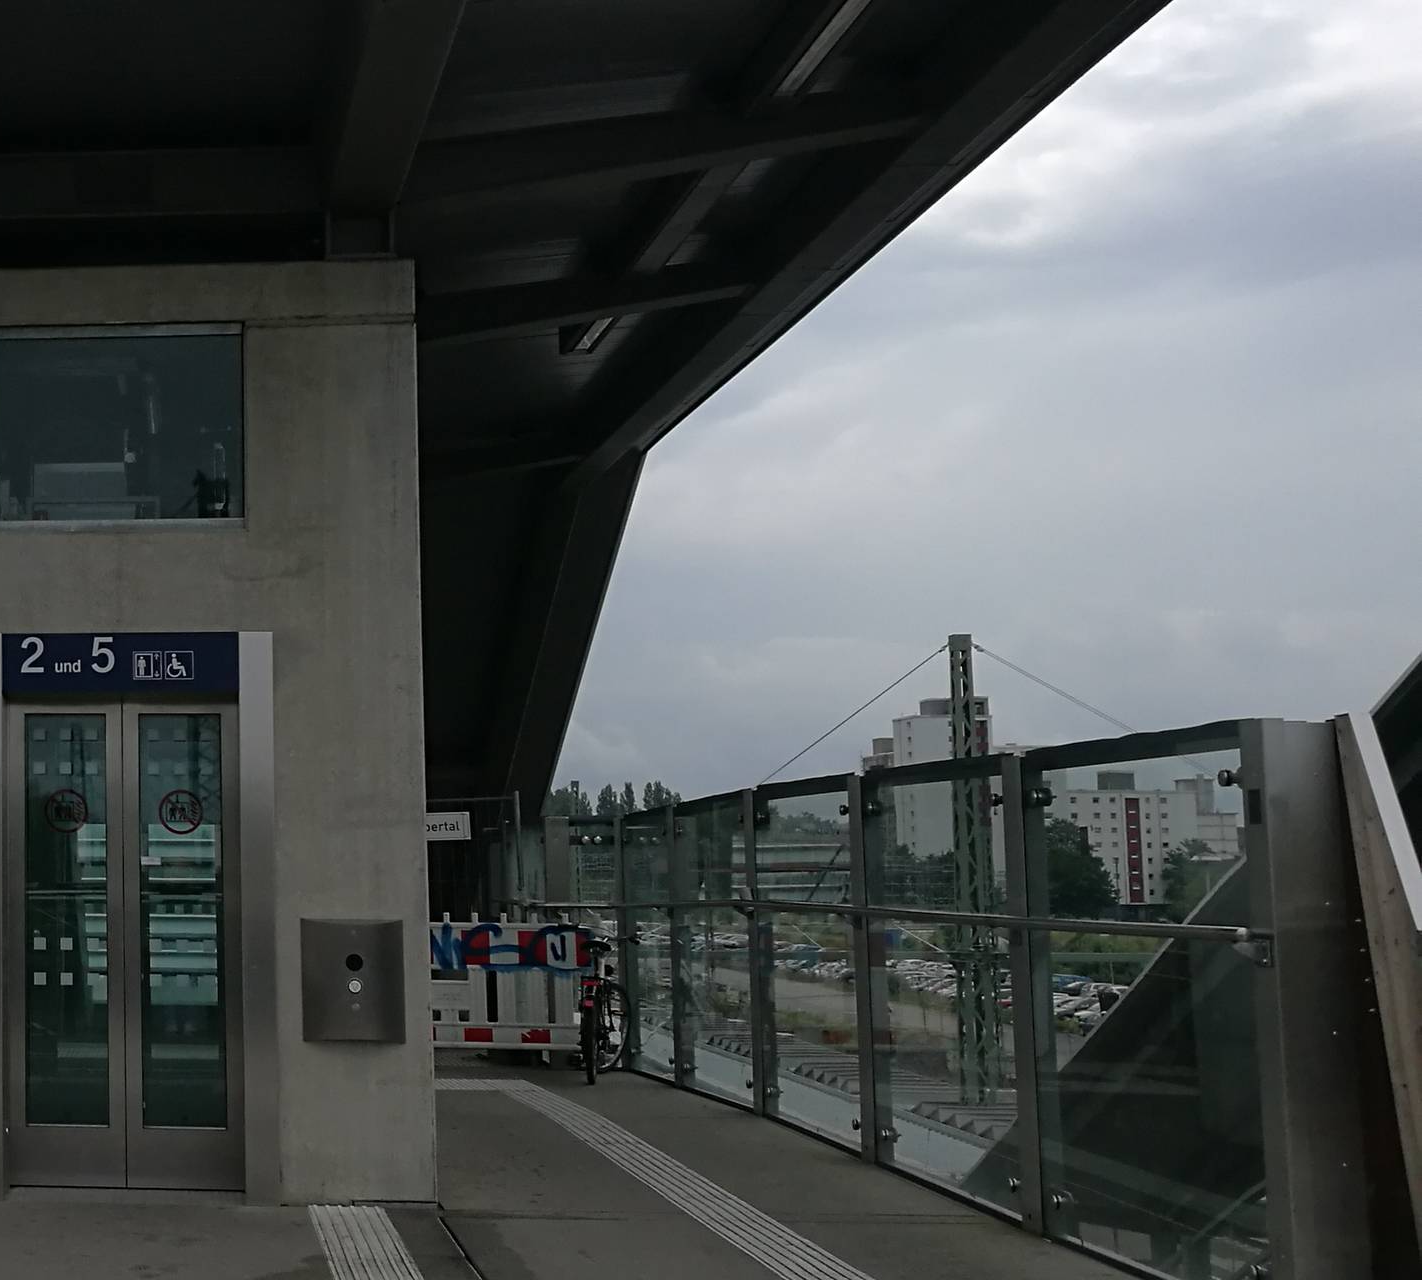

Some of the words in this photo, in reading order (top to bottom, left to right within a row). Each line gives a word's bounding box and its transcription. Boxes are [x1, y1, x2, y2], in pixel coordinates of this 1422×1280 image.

[20, 636, 45, 674] 2
[54, 659, 82, 674] und
[91, 636, 116, 674] 5
